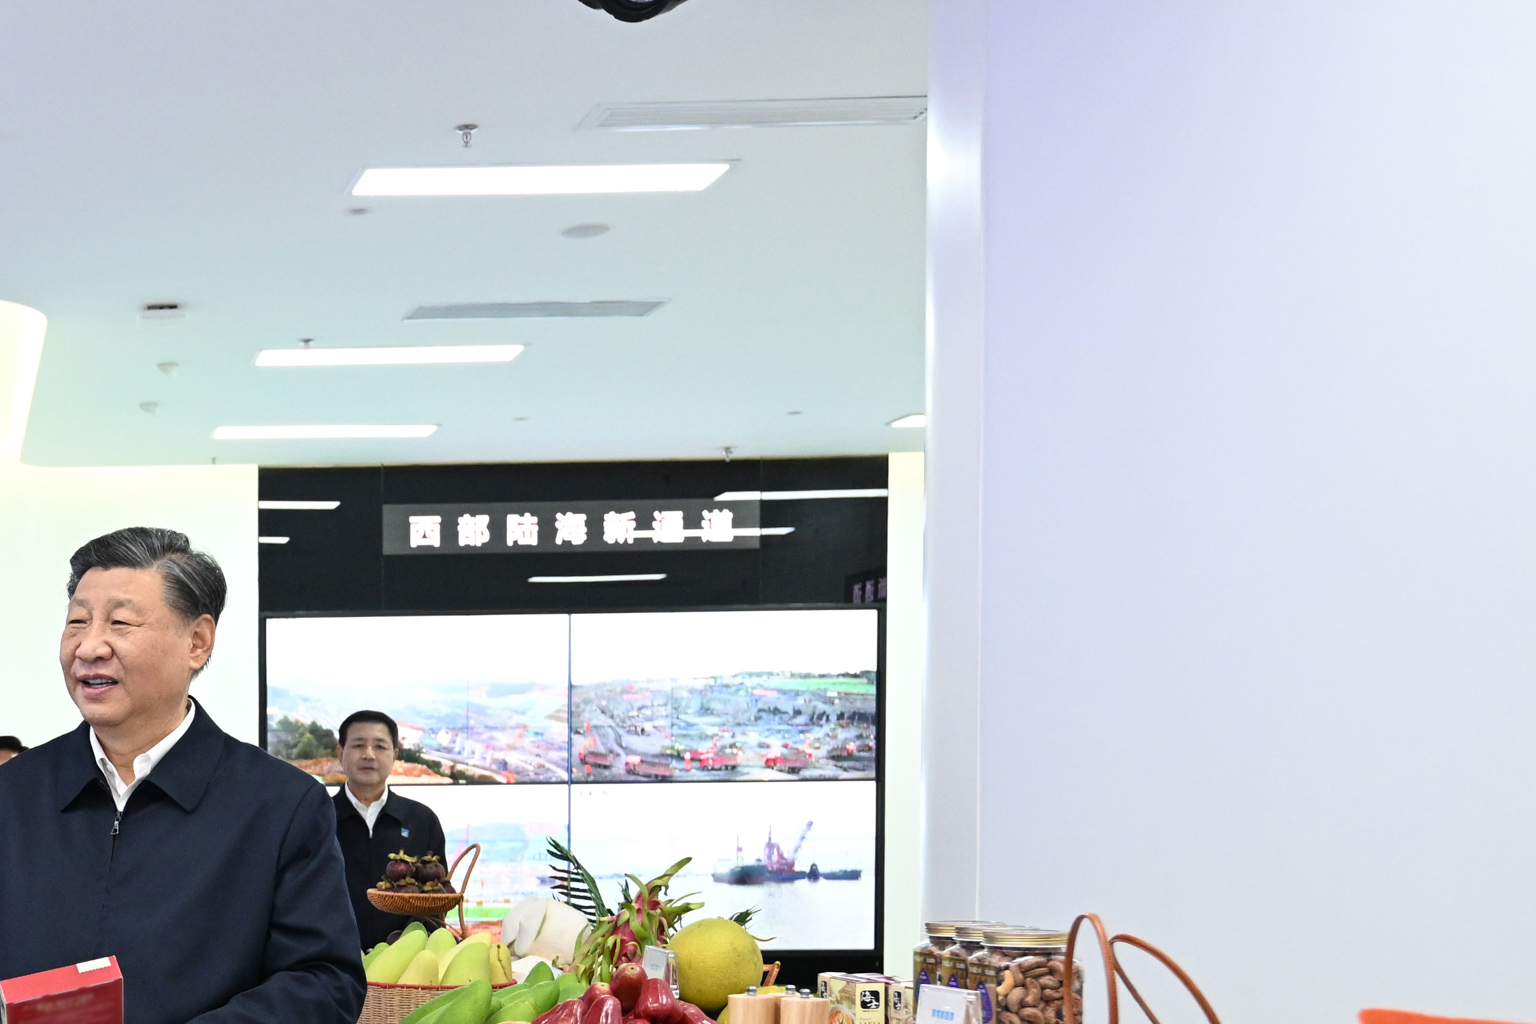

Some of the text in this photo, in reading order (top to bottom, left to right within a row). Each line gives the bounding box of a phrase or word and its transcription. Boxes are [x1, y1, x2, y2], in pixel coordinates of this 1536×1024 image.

[408, 508, 734, 548] 西部陆海新通道
